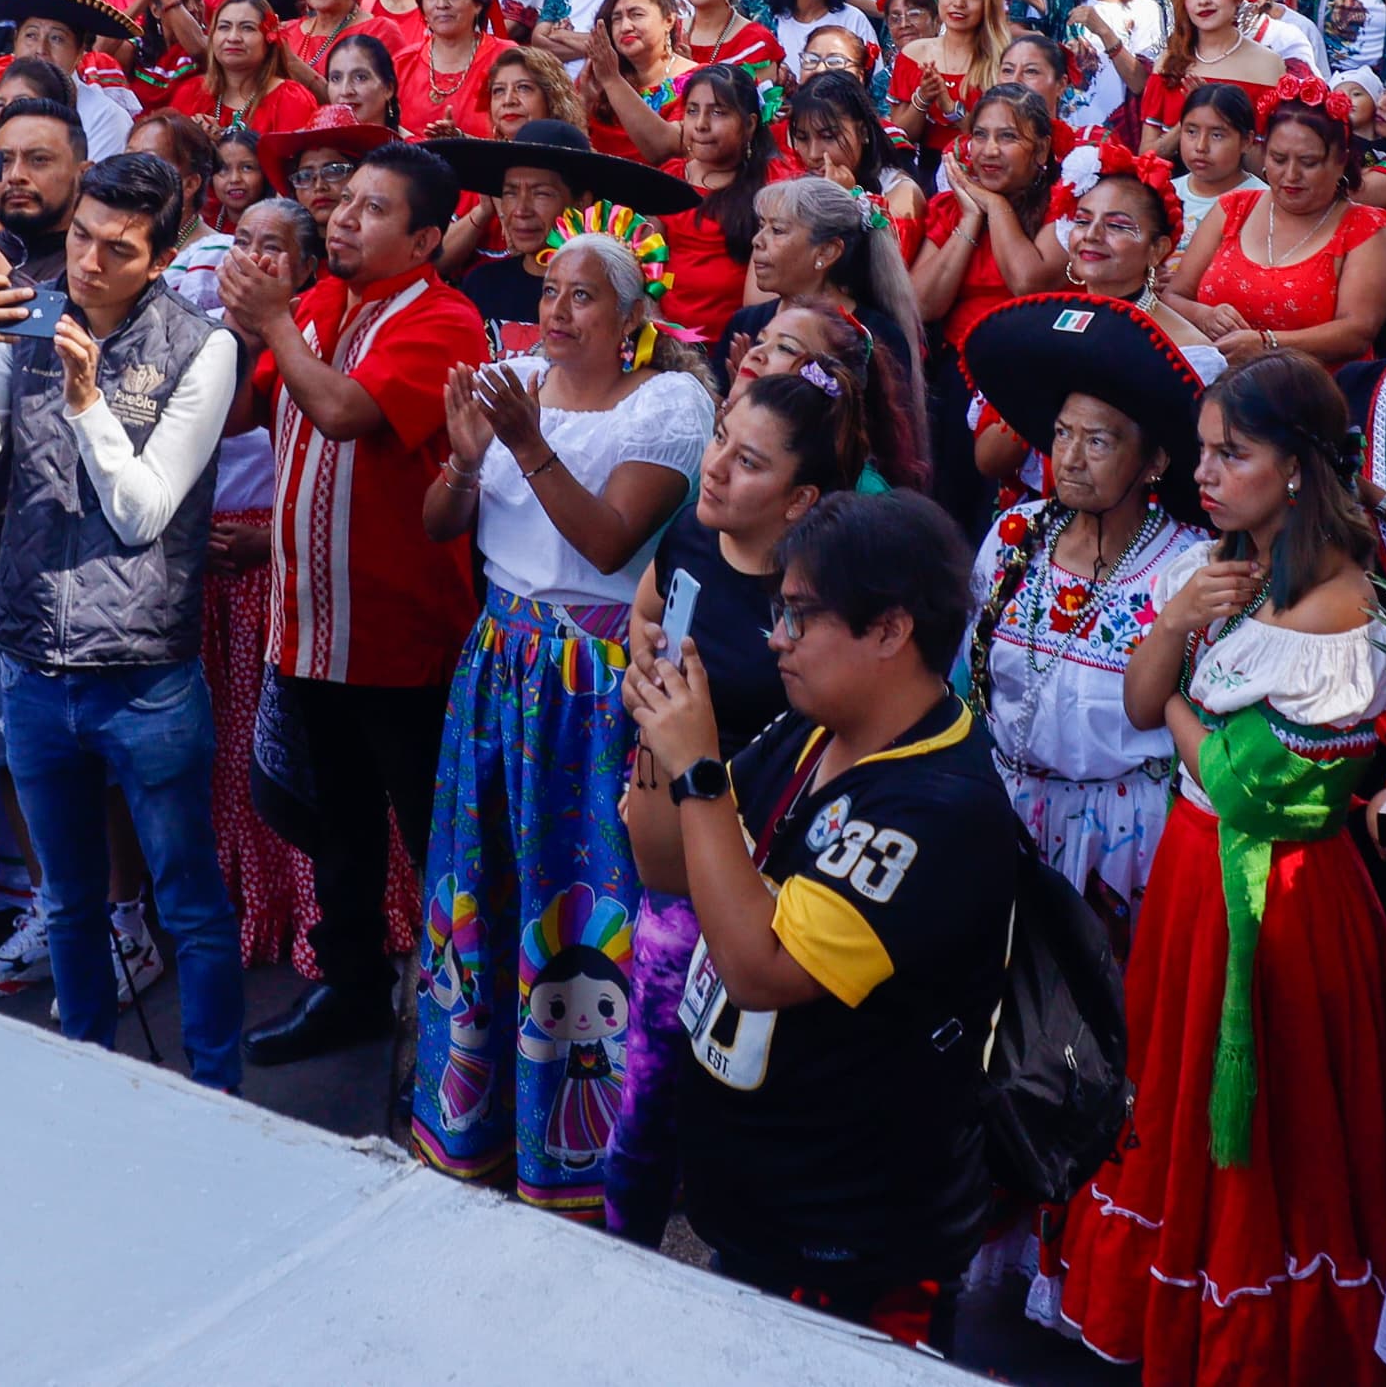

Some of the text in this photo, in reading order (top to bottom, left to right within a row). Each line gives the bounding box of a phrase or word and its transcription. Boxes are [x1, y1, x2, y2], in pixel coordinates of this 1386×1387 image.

[114, 388, 158, 412] Puebla
[815, 819, 919, 904] 33
[706, 1044, 730, 1079] EST.
